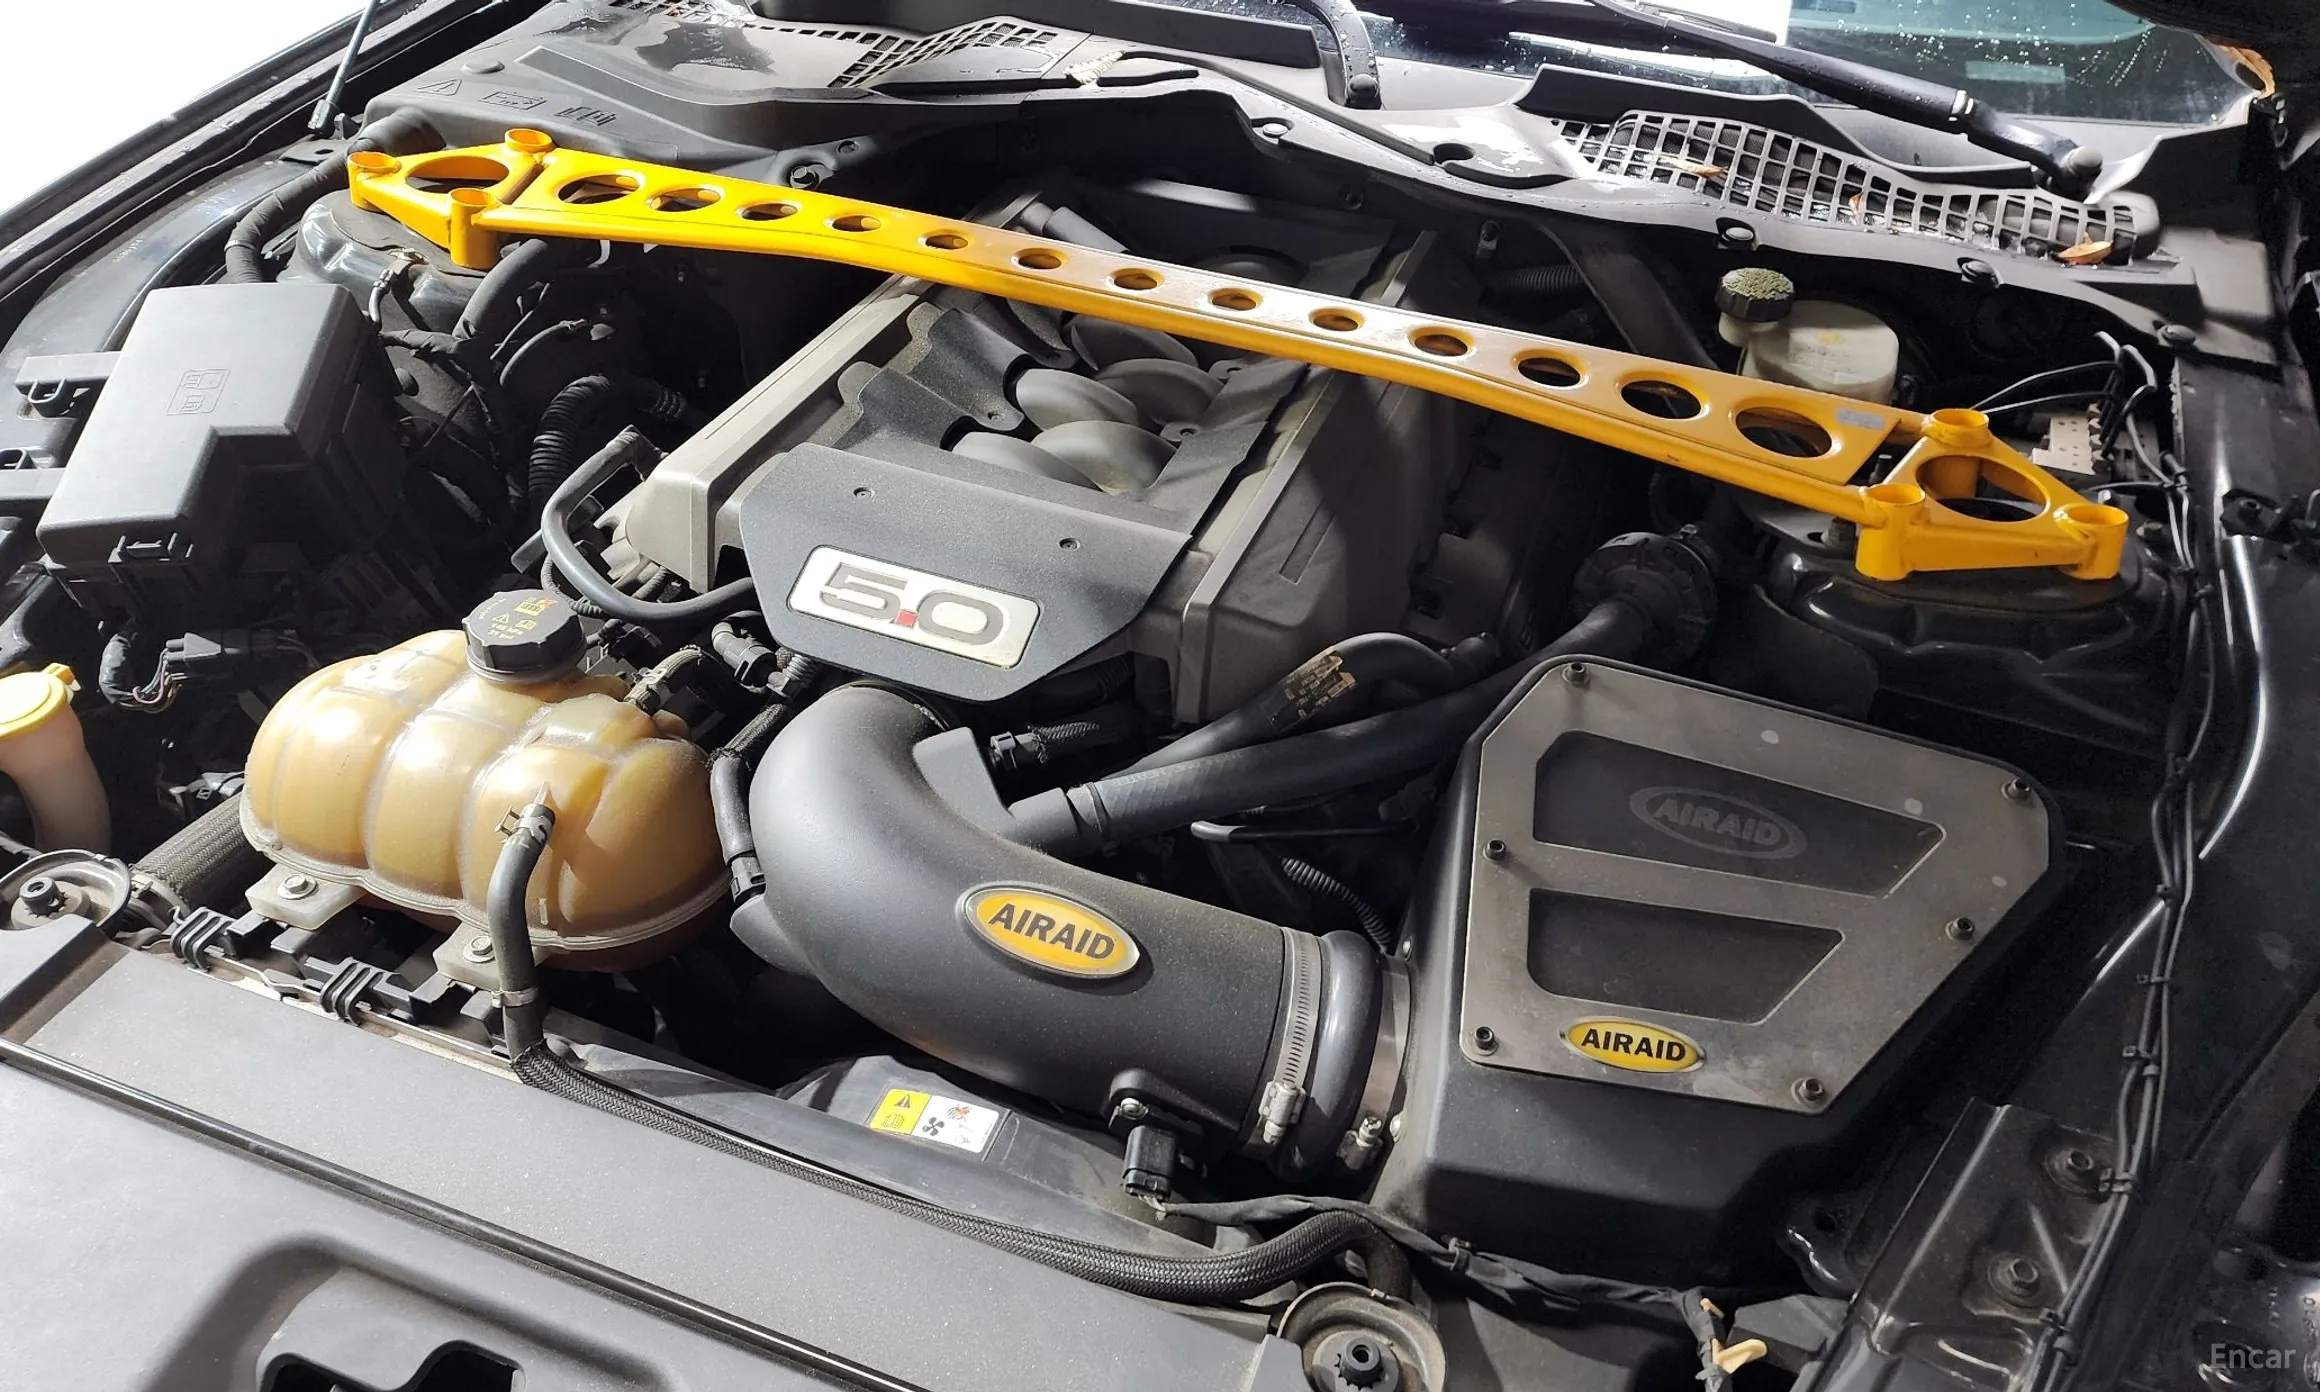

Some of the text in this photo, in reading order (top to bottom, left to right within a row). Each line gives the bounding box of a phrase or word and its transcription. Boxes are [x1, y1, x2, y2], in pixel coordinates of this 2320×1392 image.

[819, 562, 1004, 645] 5.0
[1653, 798, 1782, 846] AIRAID
[988, 903, 1115, 959] AIRAID
[1581, 1028, 1686, 1062] AIRAID
